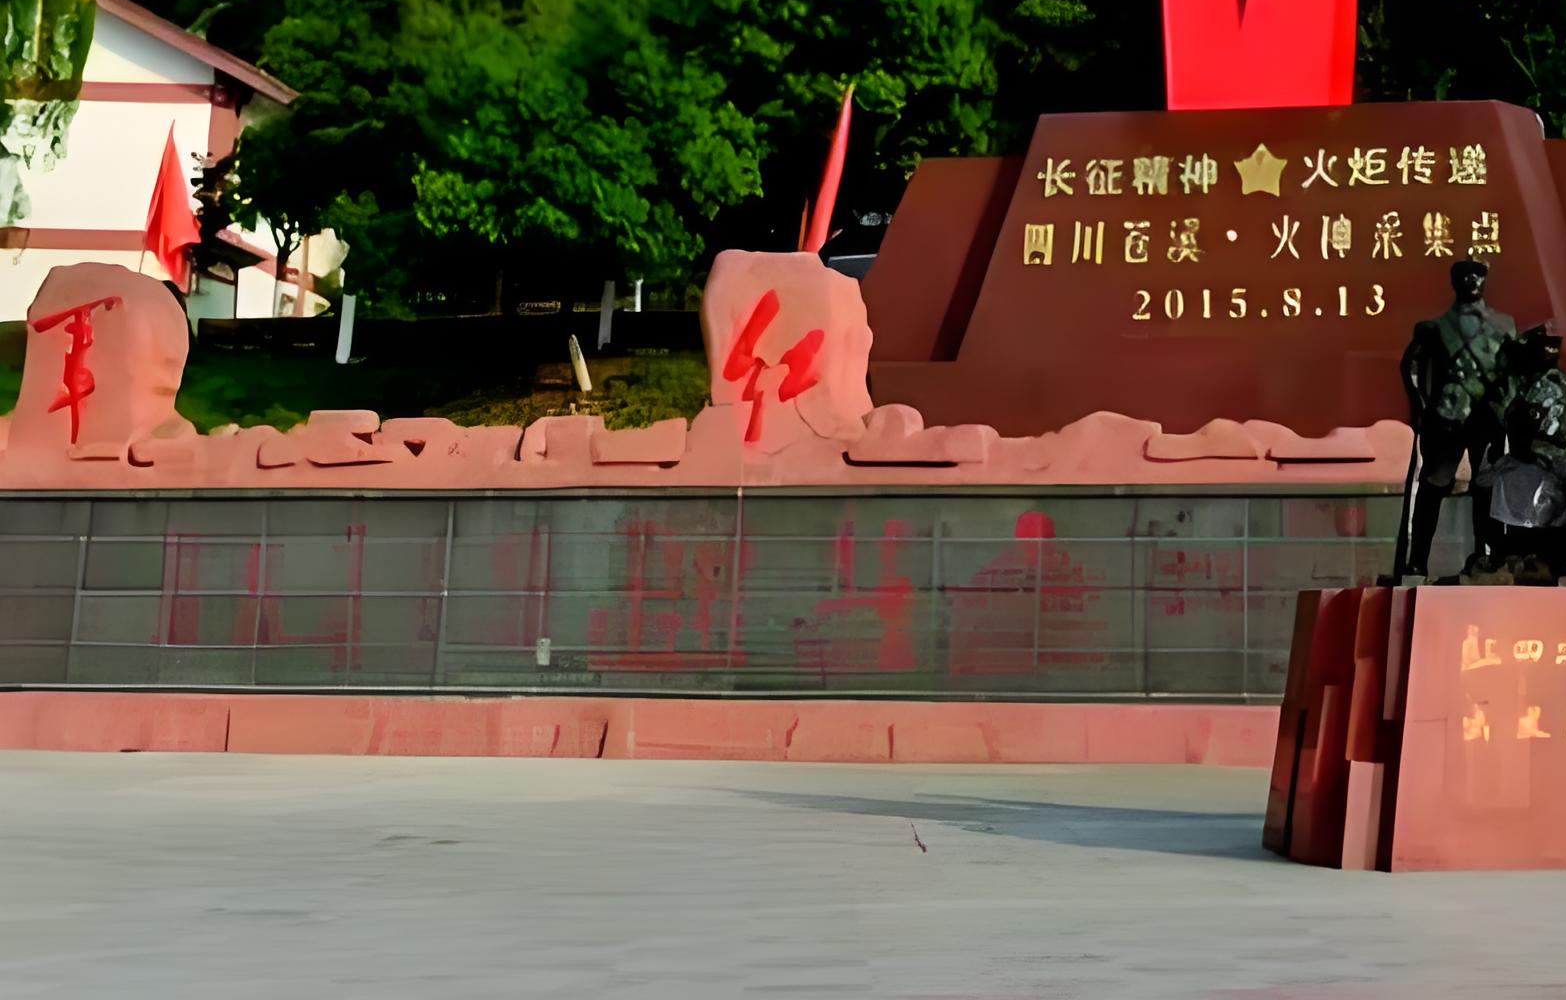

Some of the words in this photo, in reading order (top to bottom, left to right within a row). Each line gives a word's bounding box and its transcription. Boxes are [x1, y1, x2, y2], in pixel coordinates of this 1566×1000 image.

[1037, 153, 1218, 198] 长征精神
[1131, 284, 1385, 320] 2015.8.13
